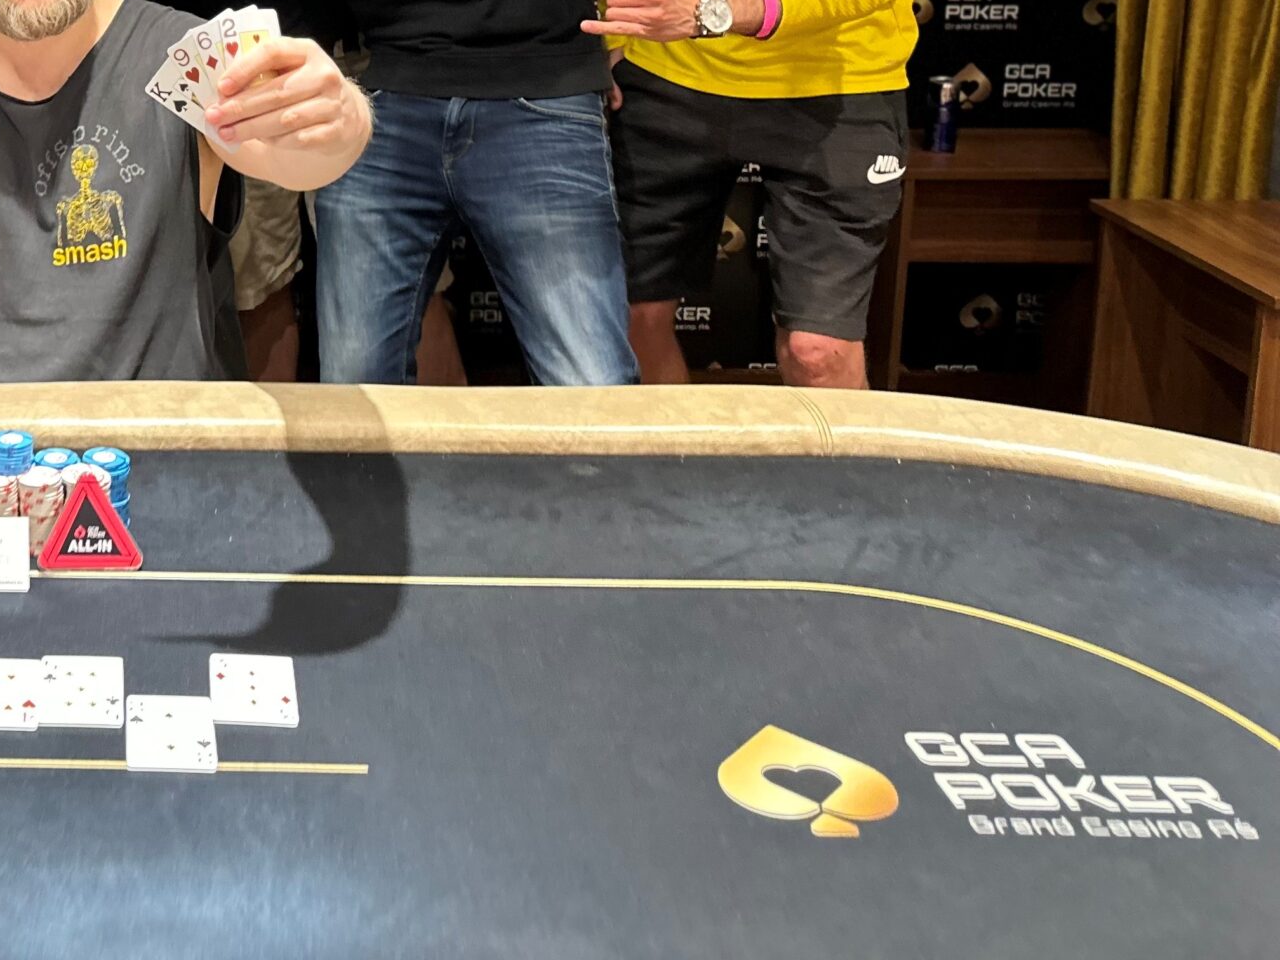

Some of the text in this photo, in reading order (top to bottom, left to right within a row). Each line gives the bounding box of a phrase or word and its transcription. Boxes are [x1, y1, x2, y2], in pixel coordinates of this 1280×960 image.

[945, 5, 1019, 20] POKER
[222, 18, 237, 38] 2
[197, 31, 213, 50] 6
[173, 48, 191, 67] 9
[1005, 64, 1051, 80] GCA
[150, 82, 173, 102] K
[1003, 83, 1077, 98] POKER
[34, 124, 145, 197] offspring
[875, 155, 900, 173] NIK
[53, 235, 128, 267] smash
[675, 307, 711, 321] KER
[67, 539, 113, 553] ALL-IN
[904, 731, 1086, 769] GCA
[933, 772, 1234, 815] POKER
[968, 814, 1076, 836] Grand
[1080, 816, 1203, 839] Casino
